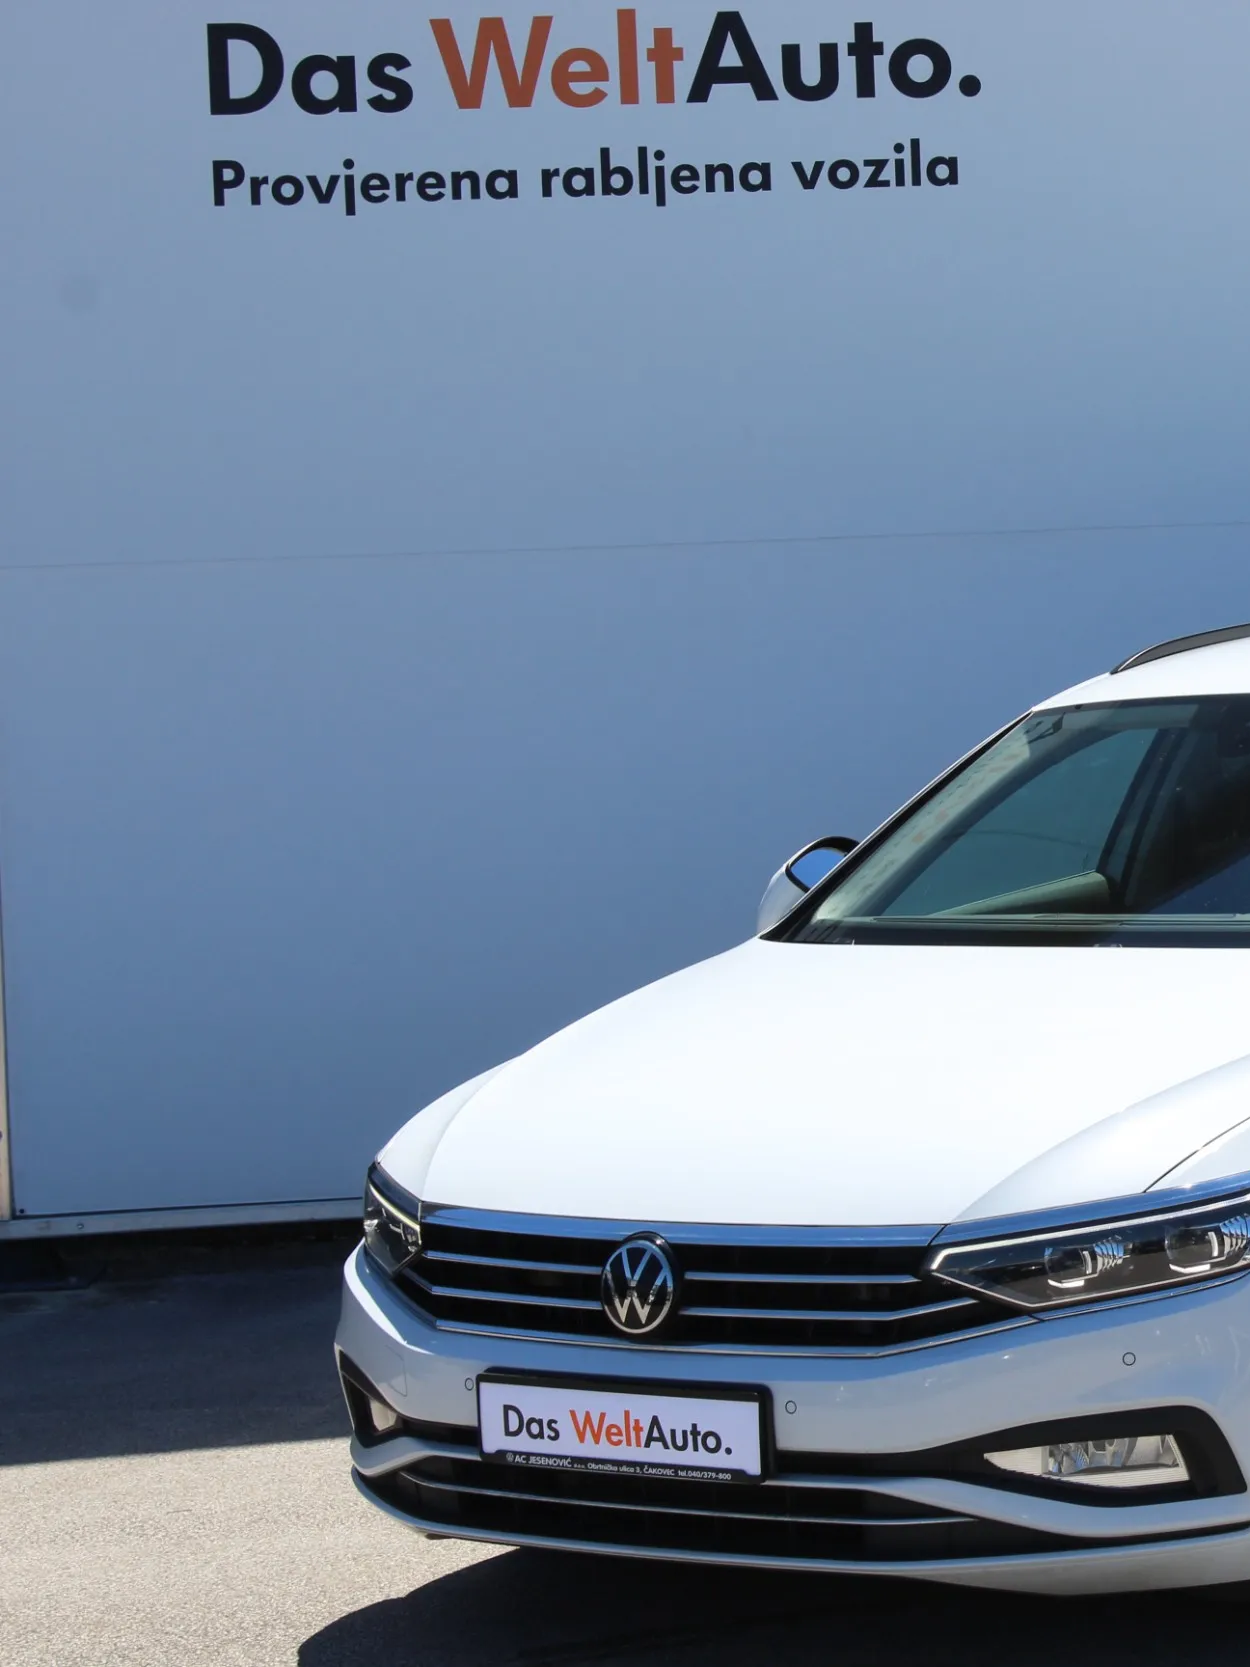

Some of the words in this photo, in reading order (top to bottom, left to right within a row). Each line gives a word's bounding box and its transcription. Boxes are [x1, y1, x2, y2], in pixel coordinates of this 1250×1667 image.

[206, 22, 414, 115] Das
[430, 8, 982, 110] WeltAuto.
[212, 158, 519, 215] Provjerena
[540, 146, 772, 207] rabljena
[791, 138, 959, 188] vozila
[503, 1404, 560, 1441] Das
[569, 1409, 733, 1455] WeltAuto.
[515, 1455, 526, 1463] AC
[528, 1455, 572, 1467] JESENOVIĆ
[619, 1464, 634, 1473] ulica
[643, 1464, 675, 1476] ČAKOVEC
